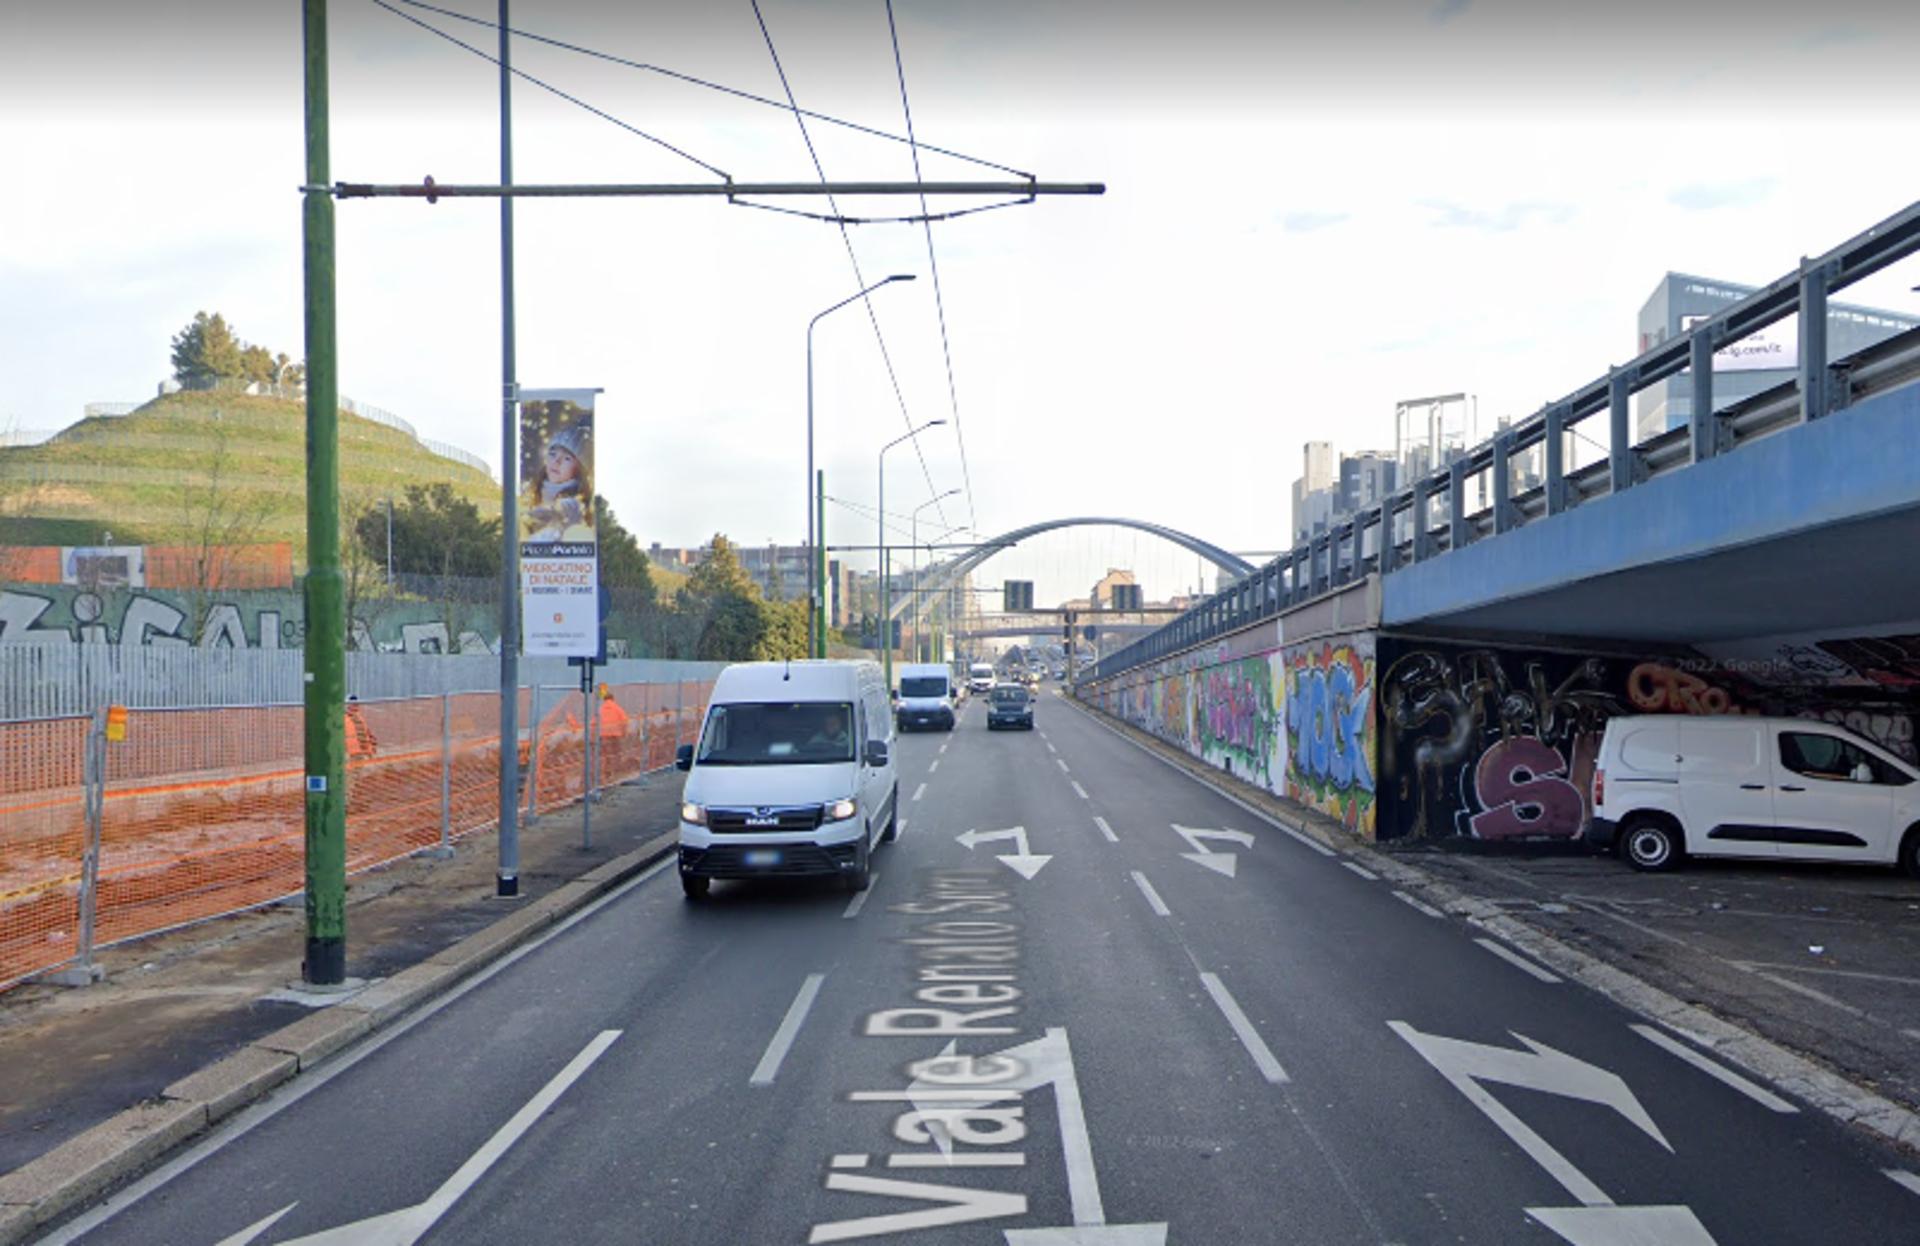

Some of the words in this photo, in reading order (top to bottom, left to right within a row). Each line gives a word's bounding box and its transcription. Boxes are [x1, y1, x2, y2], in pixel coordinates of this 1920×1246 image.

[523, 563, 593, 574] MERCATINO
[529, 575, 541, 585] DI
[544, 575, 588, 585] NATALE
[745, 817, 780, 826] MAN
